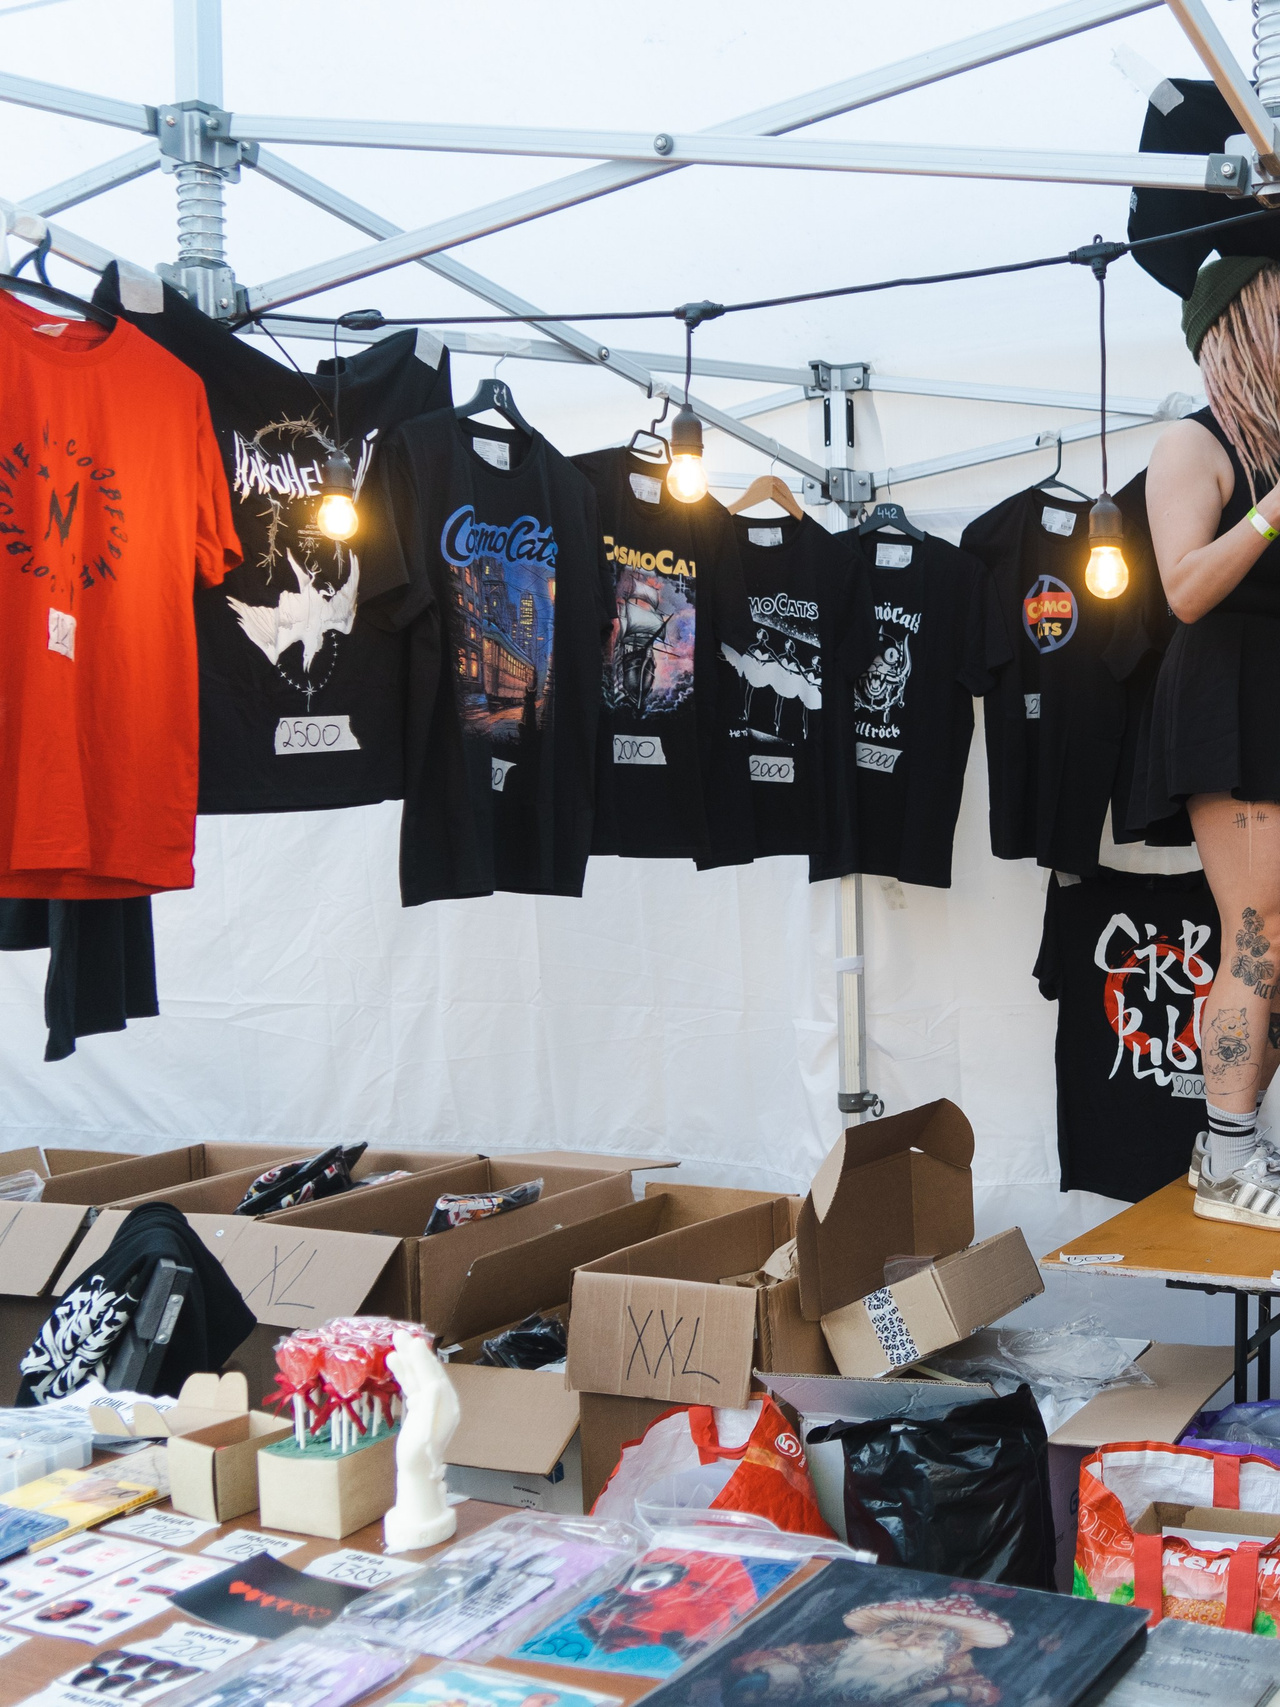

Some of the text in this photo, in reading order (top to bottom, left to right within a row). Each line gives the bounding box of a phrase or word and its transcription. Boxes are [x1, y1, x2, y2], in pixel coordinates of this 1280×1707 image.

[877, 507, 898, 519] 442
[280, 719, 341, 748] 2500
[614, 737, 655, 761] 2000
[857, 748, 895, 769] 2000
[750, 760, 790, 778] 2000
[626, 1305, 720, 1384] XXL
[326, 1561, 392, 1584] 1300
